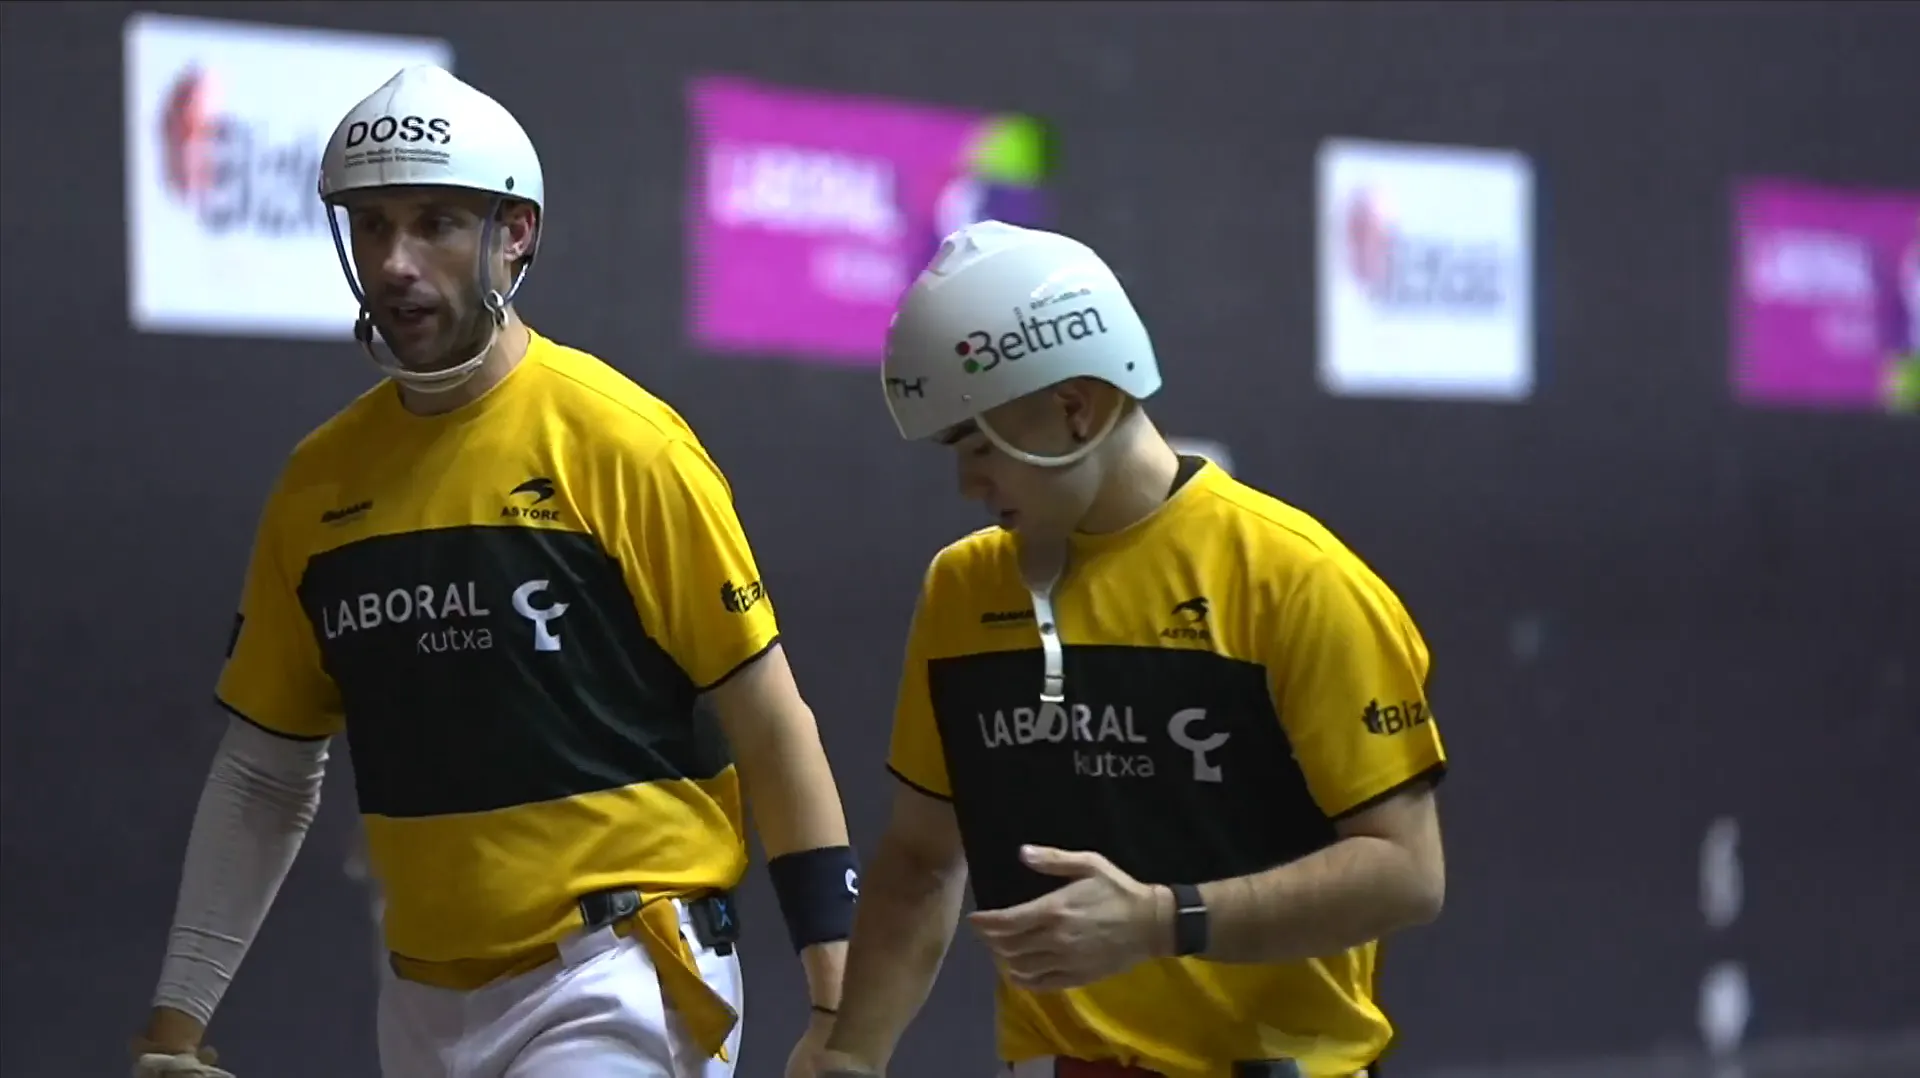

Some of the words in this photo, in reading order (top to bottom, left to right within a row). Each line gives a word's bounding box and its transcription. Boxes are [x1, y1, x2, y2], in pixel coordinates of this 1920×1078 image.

[345, 115, 451, 149] DOSS
[967, 306, 1108, 372] Beltran
[500, 505, 561, 521] ASTORE
[322, 581, 491, 639] LABORAL
[416, 626, 493, 654] kutxa
[1160, 627, 1211, 641] ASTOR
[977, 703, 1148, 748] LABORAL
[1073, 750, 1156, 777] kutxa
